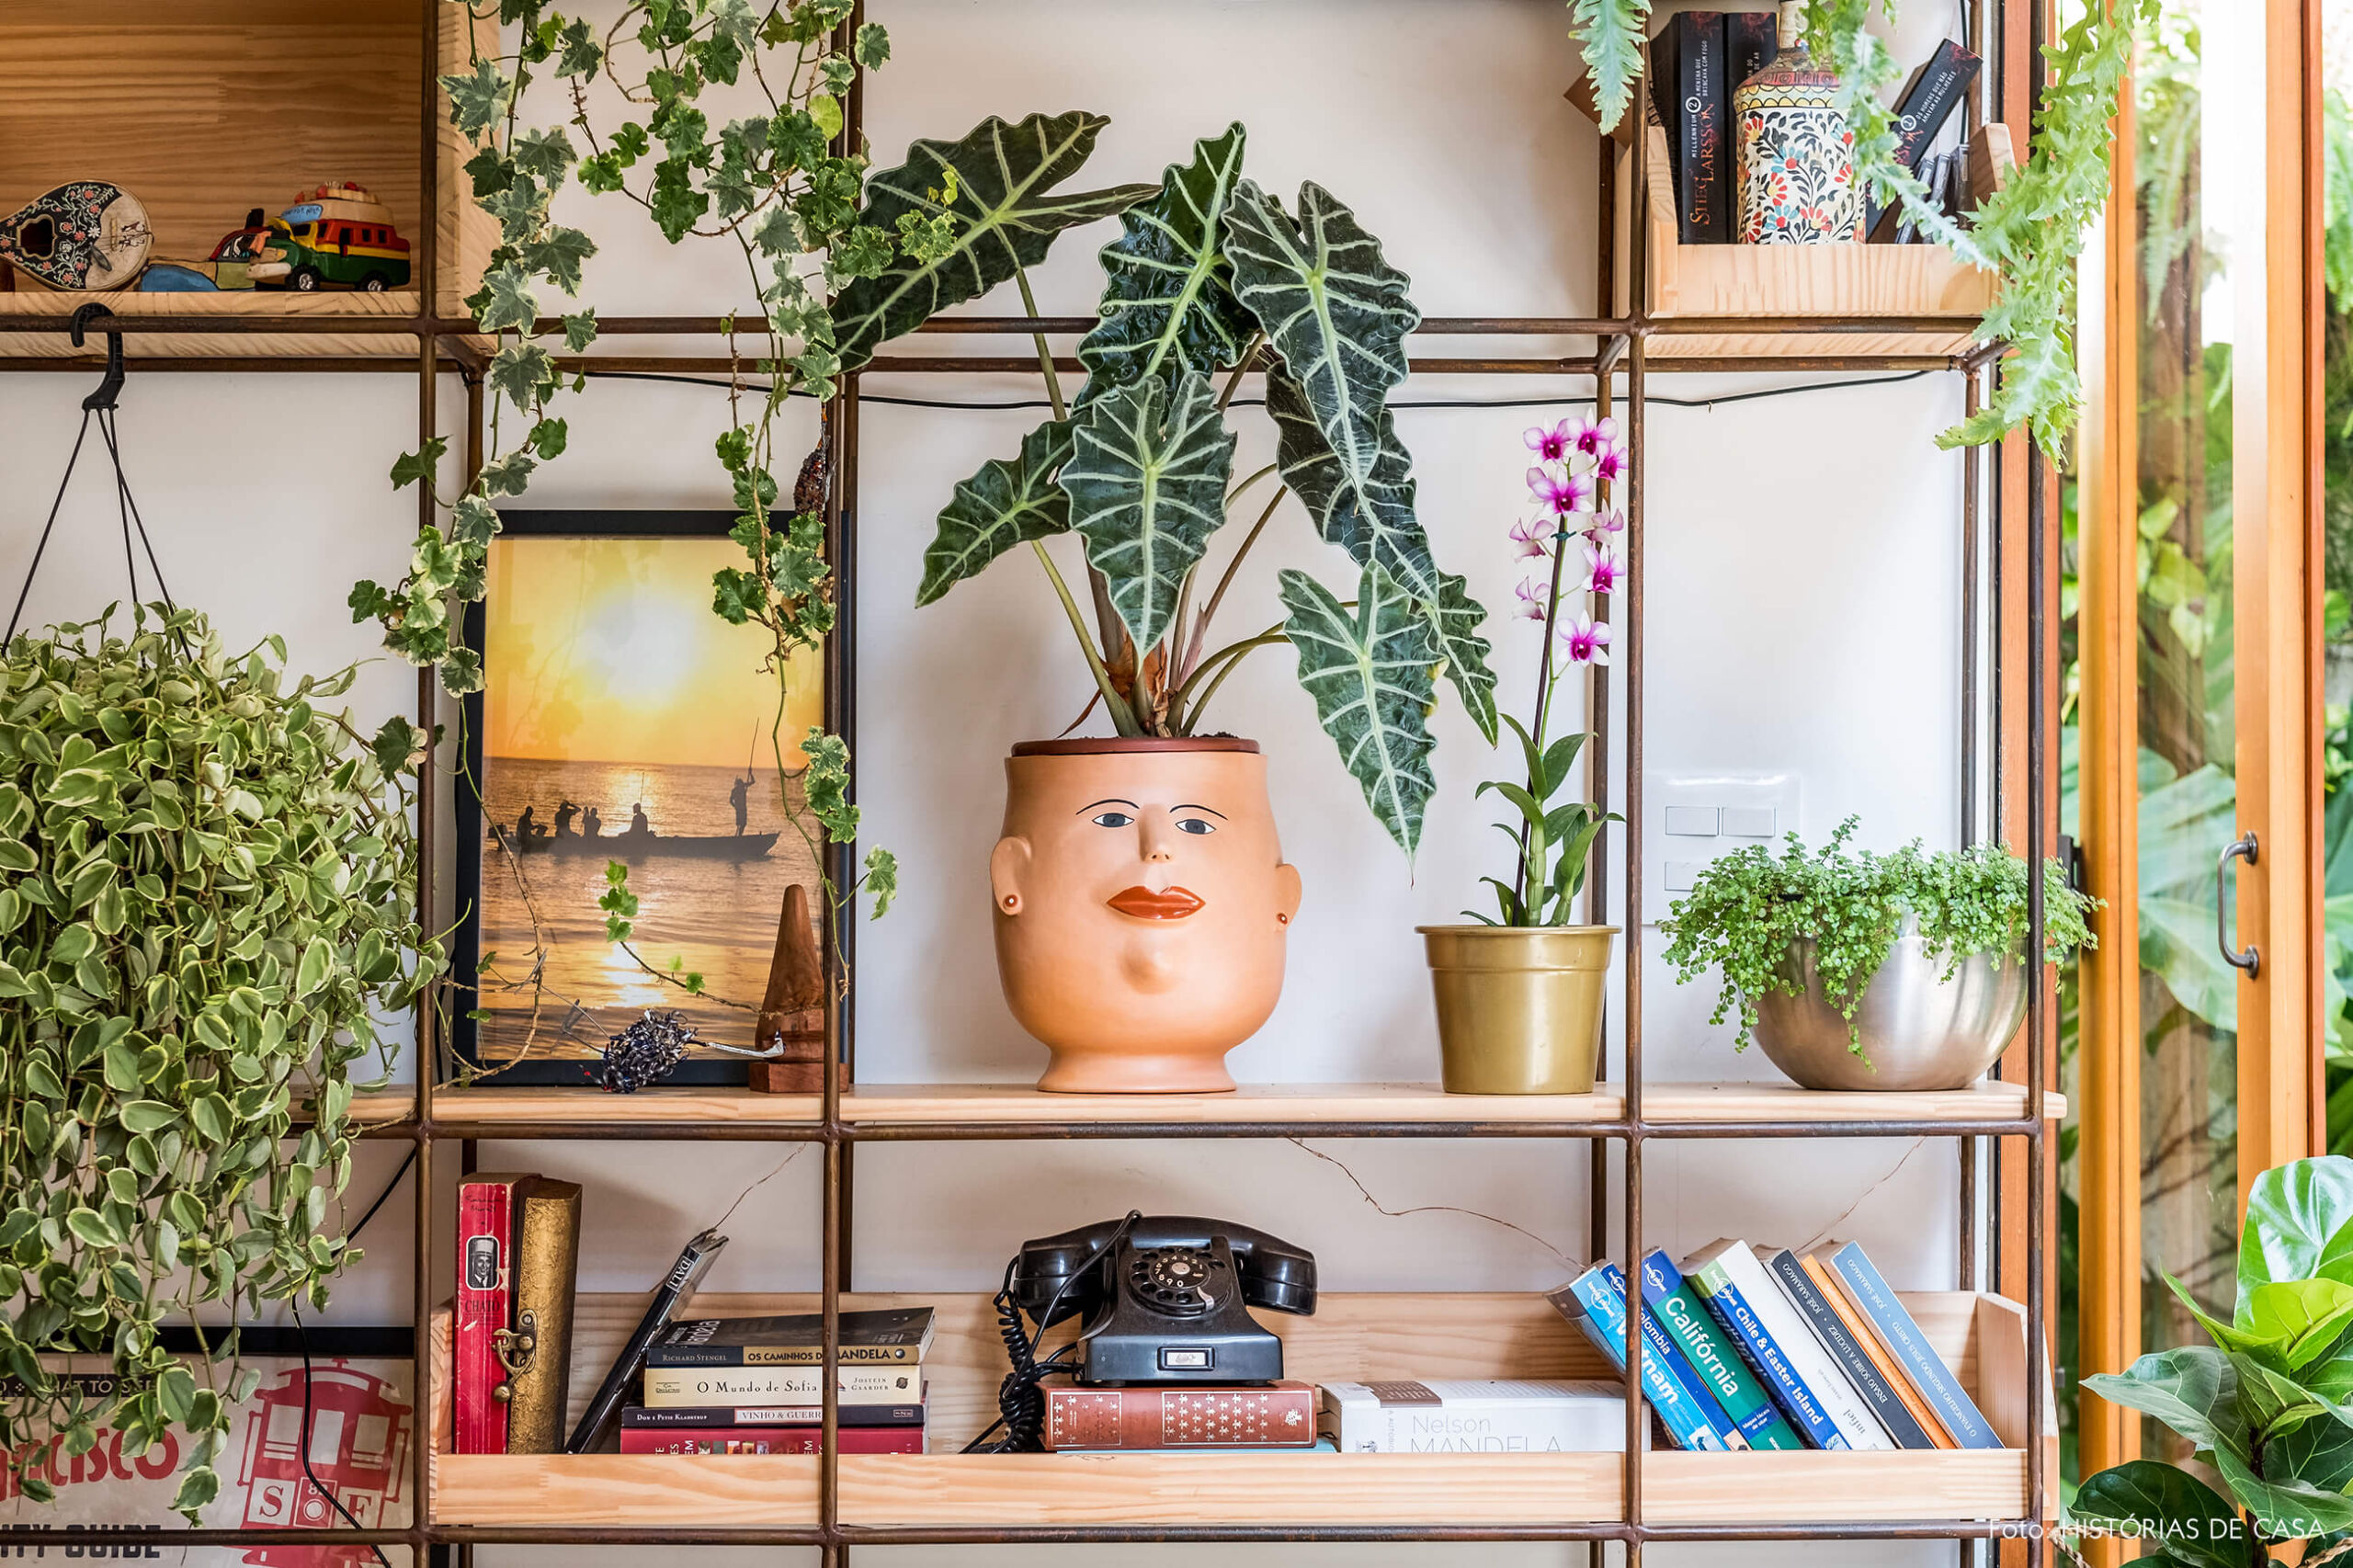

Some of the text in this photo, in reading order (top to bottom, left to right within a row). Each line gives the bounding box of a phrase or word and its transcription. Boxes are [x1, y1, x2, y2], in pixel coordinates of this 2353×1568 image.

[1782, 1264, 1809, 1297] SARAMAGO
[1847, 1260, 1874, 1292] SARAMAGO
[1641, 1307, 1671, 1356] olombia
[1828, 1325, 1850, 1352] LUCIDEZ
[748, 1353, 761, 1361] OS
[764, 1352, 813, 1361] CAMINHOS
[1666, 1298, 1739, 1394] Califórnia
[1734, 1307, 1759, 1336] Chile
[1756, 1336, 1768, 1349] &
[1764, 1349, 1795, 1386] Easter
[1791, 1388, 1822, 1424] Island
[1852, 1358, 1870, 1379] SOBRE
[1920, 1362, 1946, 1392] SEGUNDO
[89, 1380, 113, 1393] TO
[697, 1380, 817, 1393] O Mundo de Sofia
[1867, 1379, 1887, 1403] ENSAIO
[742, 1412, 775, 1420] VINHO
[787, 1411, 823, 1419] GUERR
[1413, 1415, 1491, 1434] Nelson
[259, 1485, 284, 1517] S
